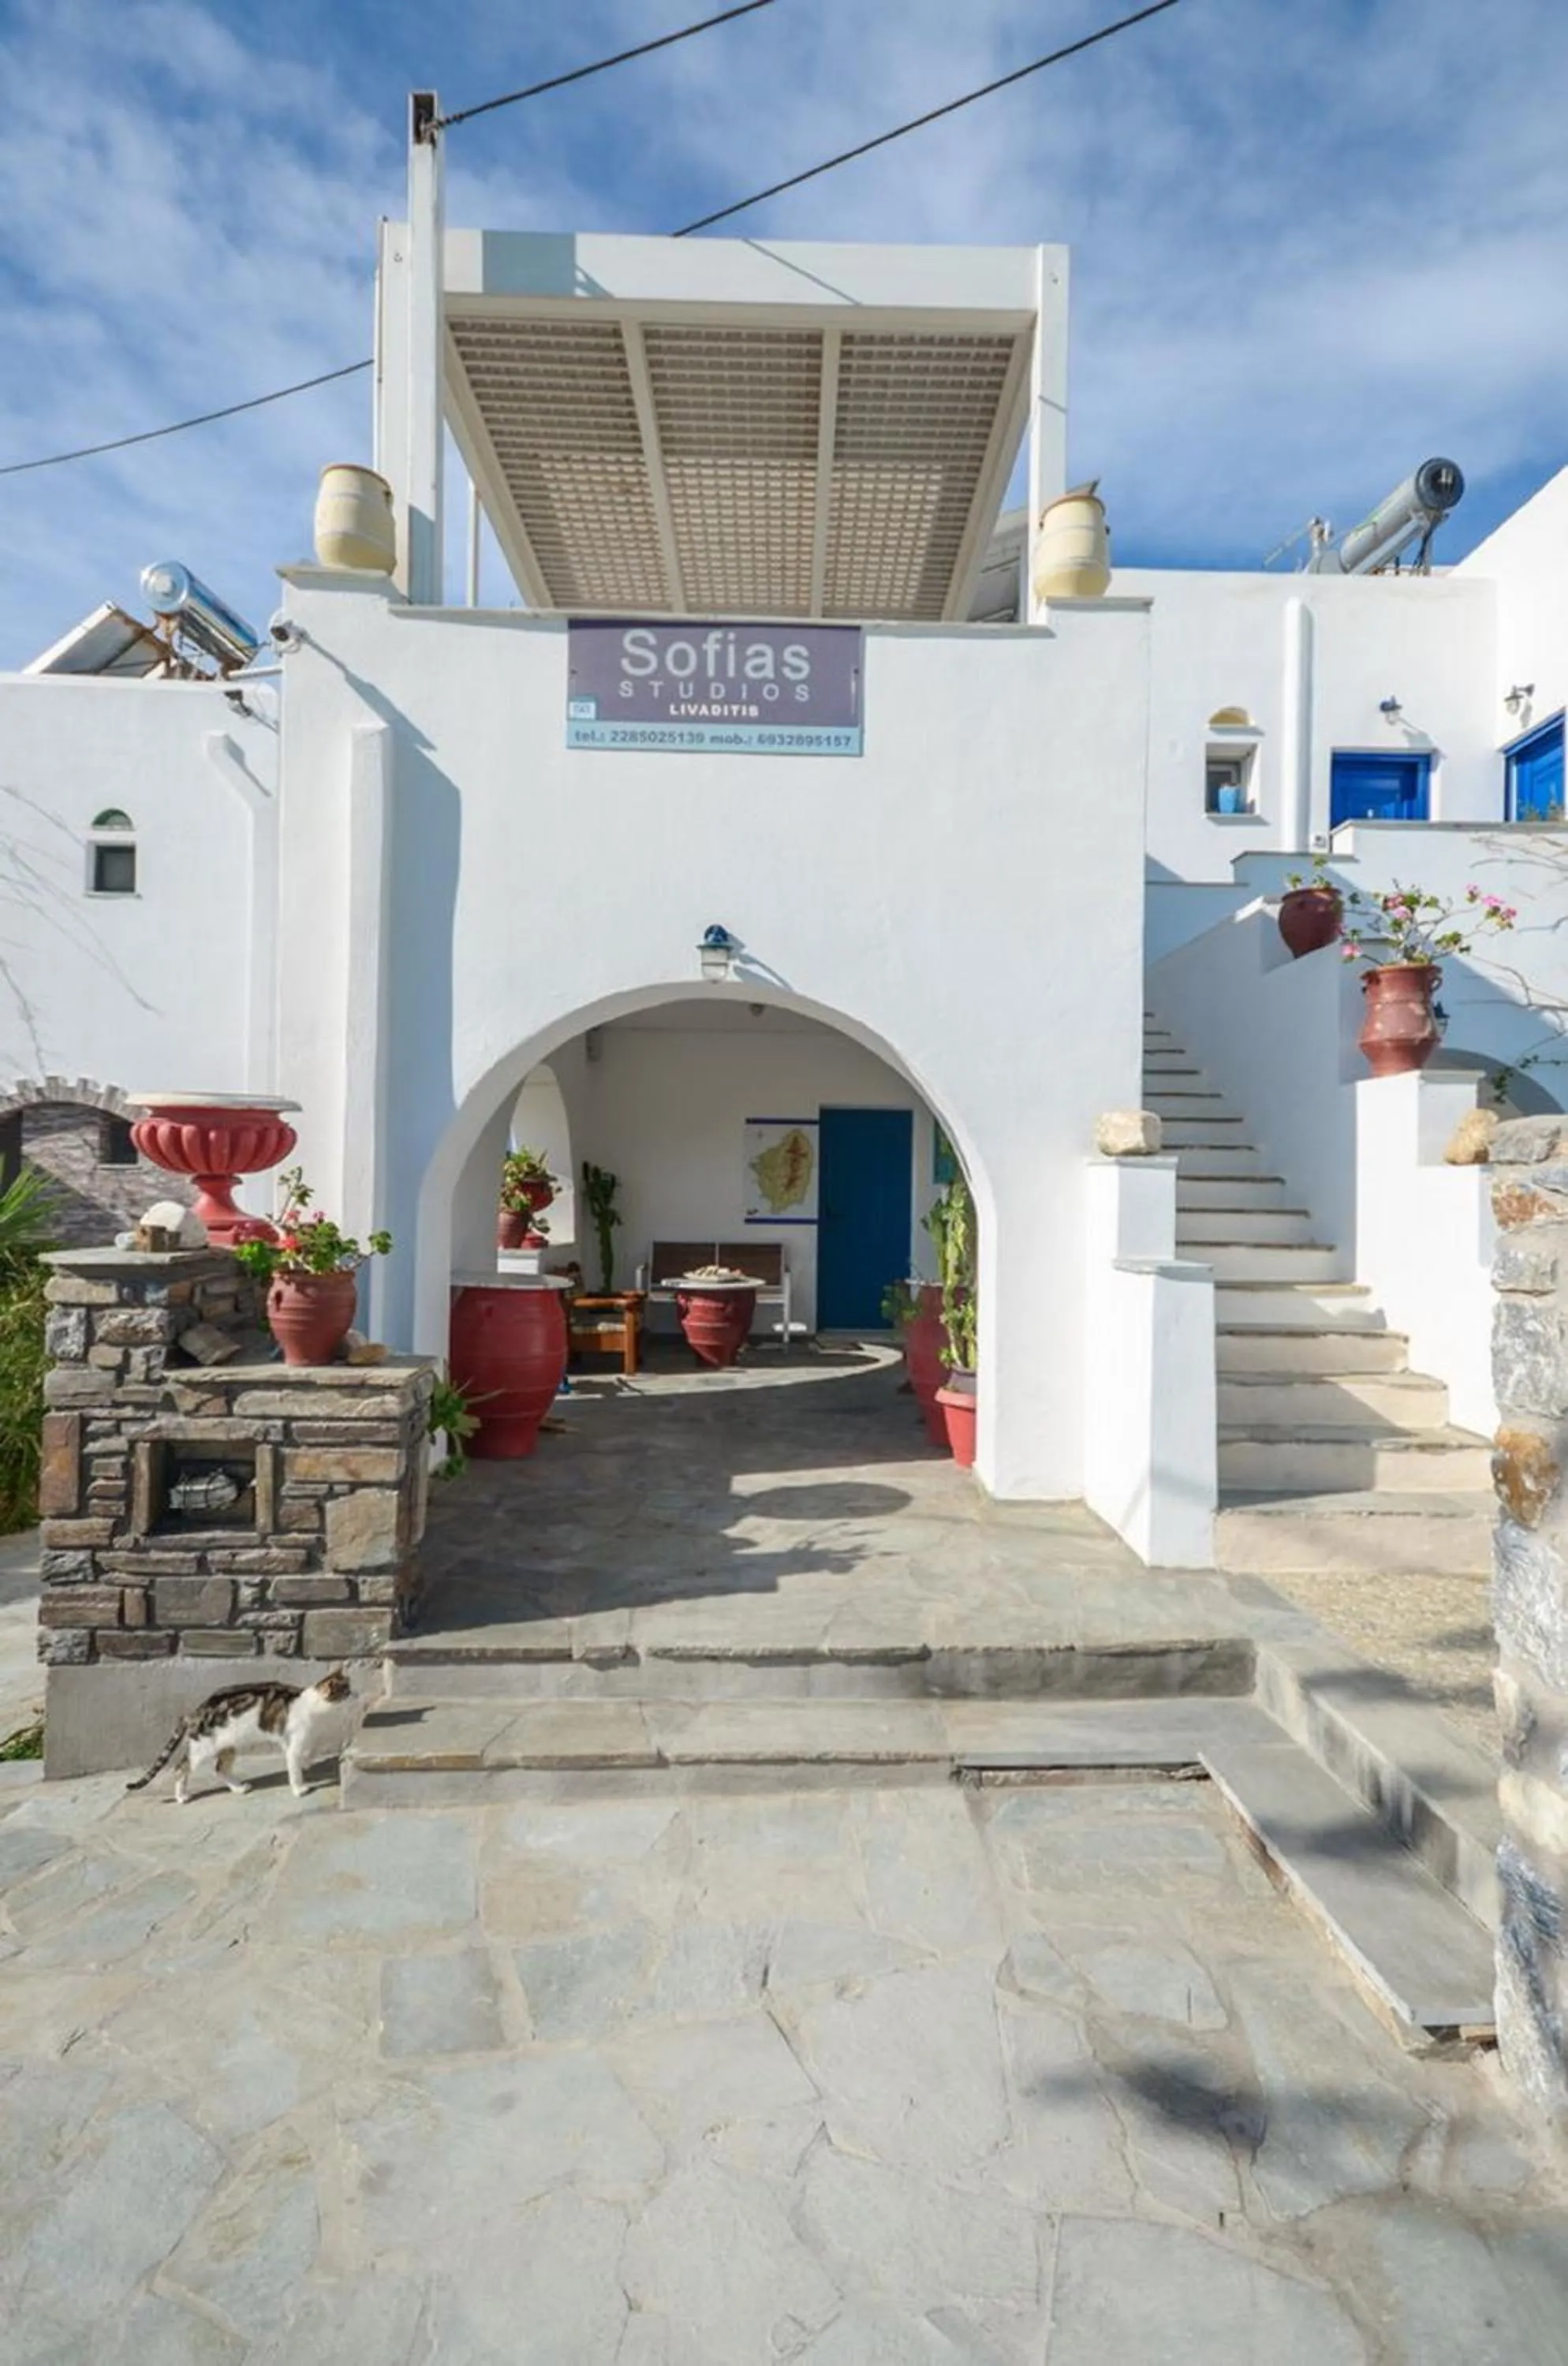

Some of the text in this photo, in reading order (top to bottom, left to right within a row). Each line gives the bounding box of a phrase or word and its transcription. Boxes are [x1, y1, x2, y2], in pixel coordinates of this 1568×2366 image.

[621, 628, 811, 681] Sofias
[618, 681, 811, 701] STUDIOS
[669, 703, 760, 718] LIVADITIS
